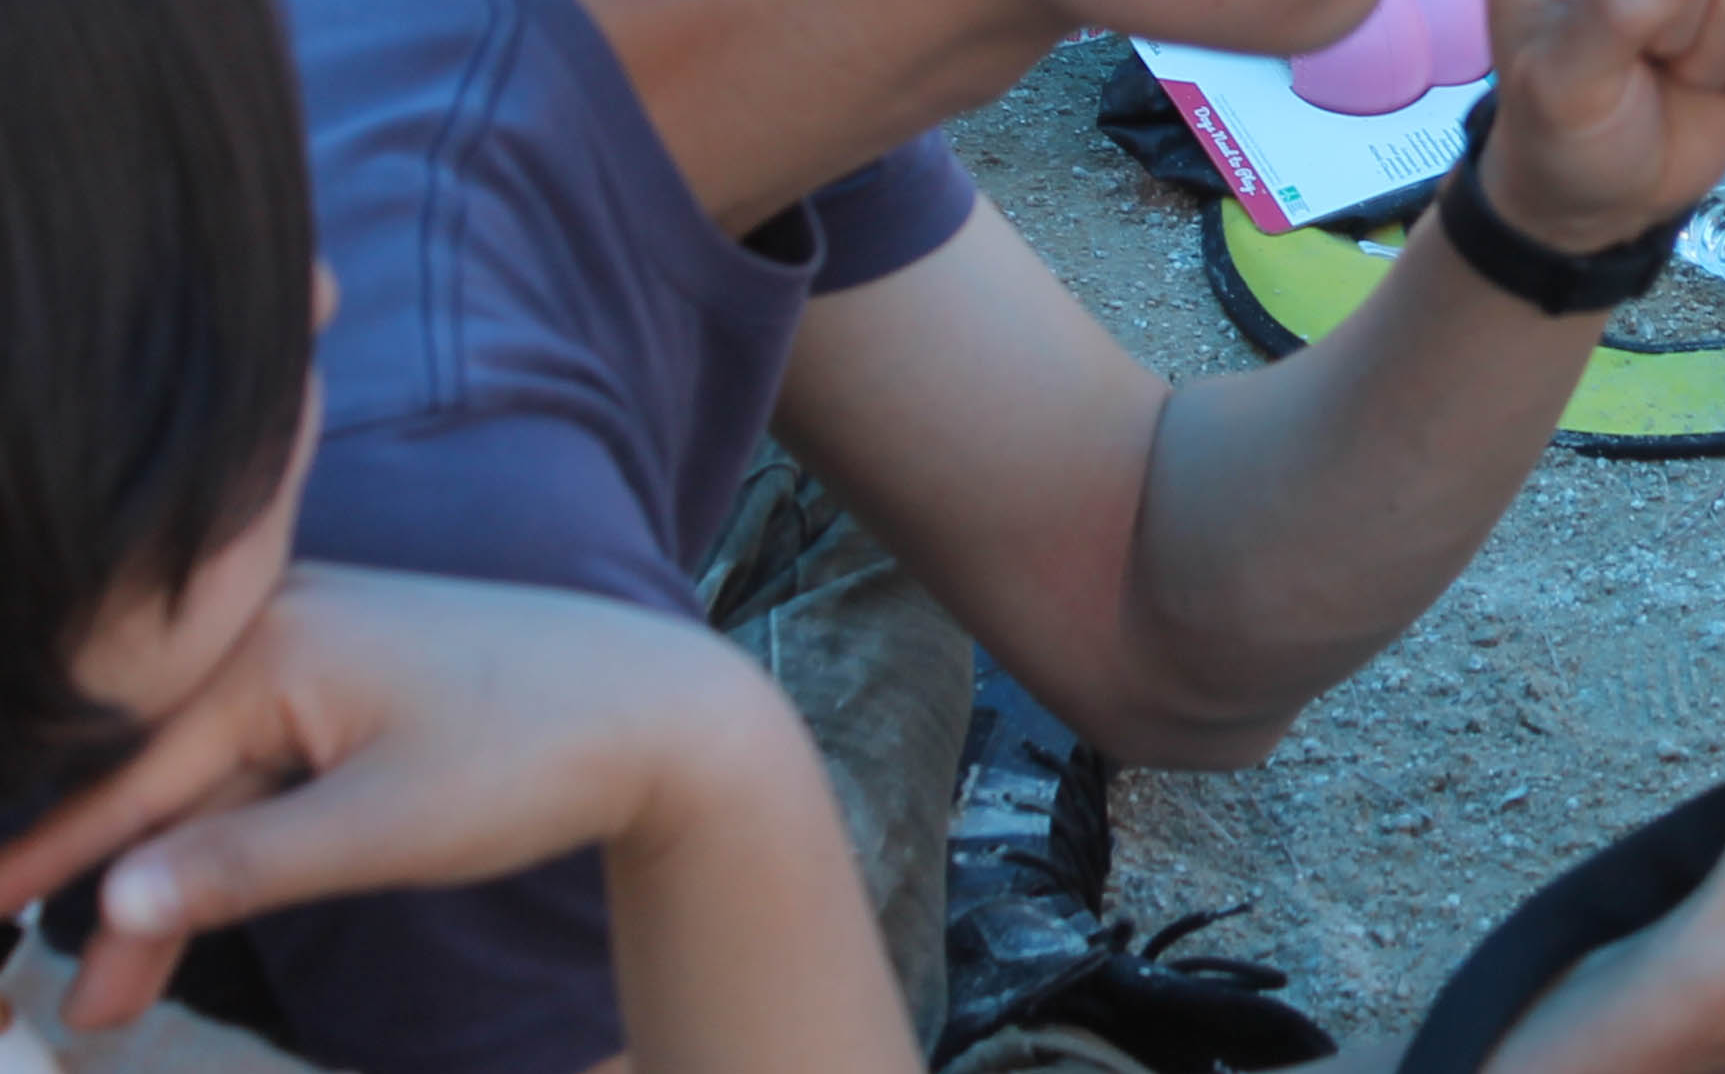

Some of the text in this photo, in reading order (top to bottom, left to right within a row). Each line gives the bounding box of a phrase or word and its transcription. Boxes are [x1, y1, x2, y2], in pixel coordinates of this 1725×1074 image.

[1194, 106, 1217, 133] Dogs
[1211, 130, 1240, 158] Need
[1228, 156, 1244, 169] to
[1234, 167, 1257, 196] Play
